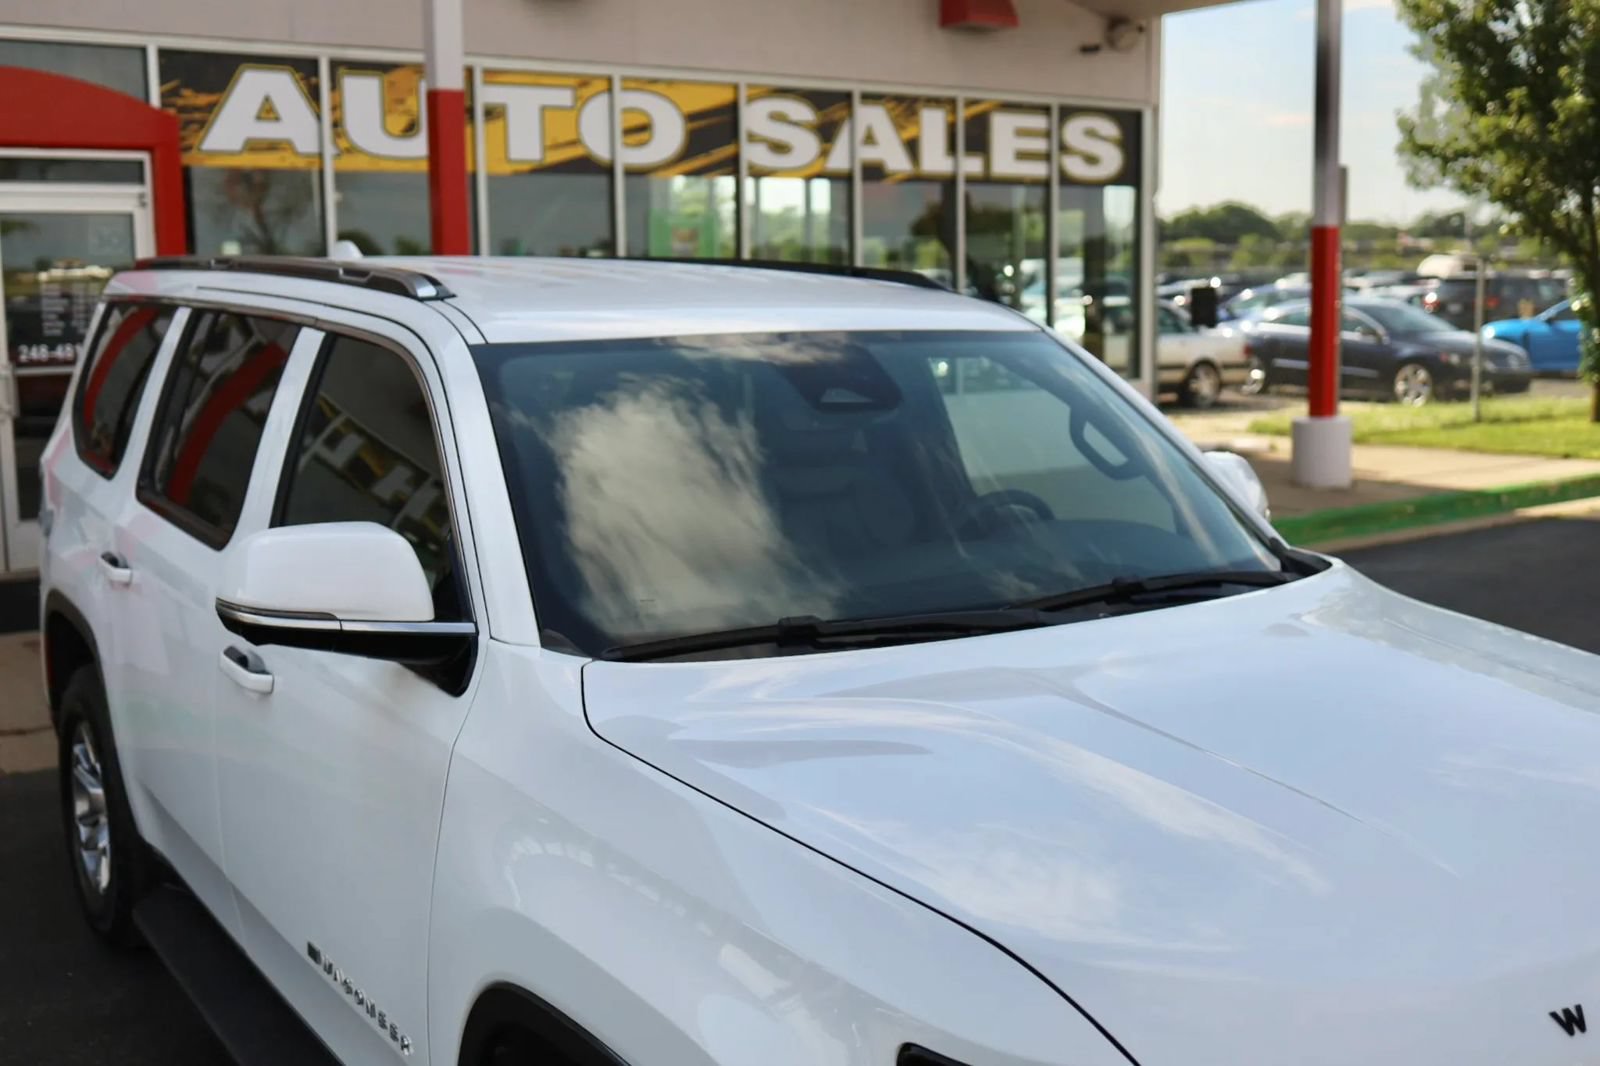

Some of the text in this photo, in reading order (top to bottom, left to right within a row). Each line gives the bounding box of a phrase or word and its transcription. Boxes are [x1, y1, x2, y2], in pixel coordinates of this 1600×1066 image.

[198, 64, 1124, 181] AUTO SALES
[1548, 1003, 1587, 1037] W
